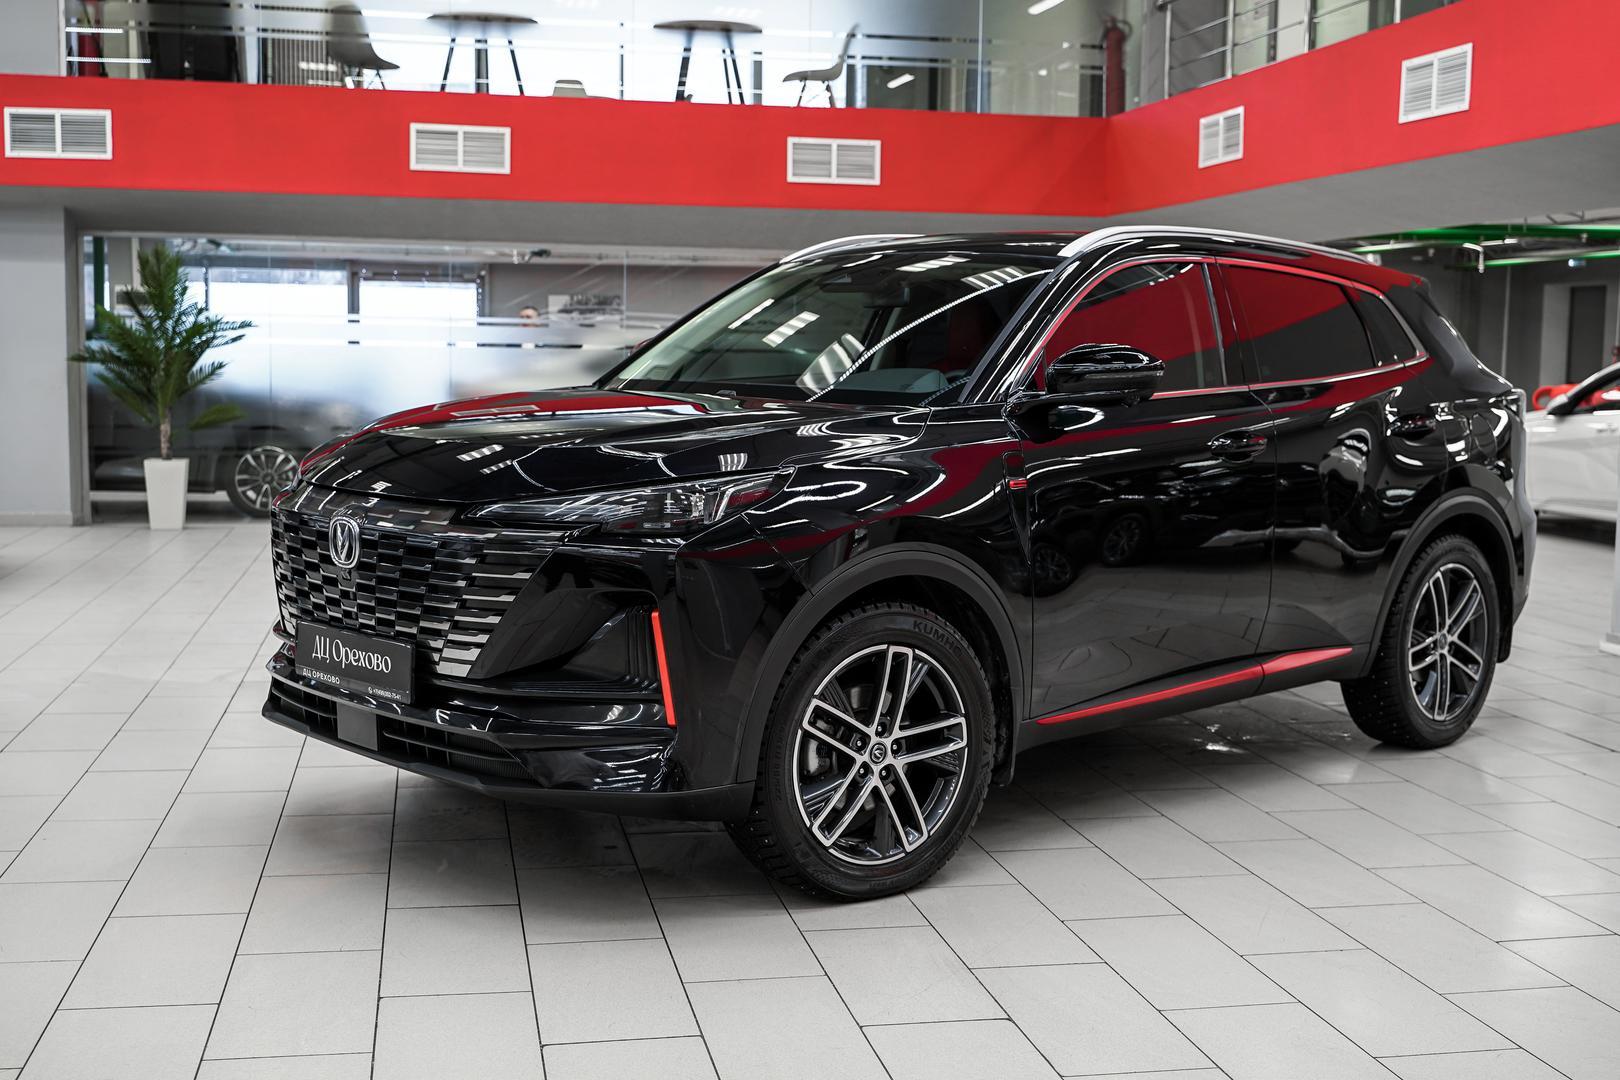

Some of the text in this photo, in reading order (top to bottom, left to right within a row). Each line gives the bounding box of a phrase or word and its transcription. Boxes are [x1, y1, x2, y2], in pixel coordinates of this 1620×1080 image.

[312, 635, 391, 673] ДЦ Орехово
[302, 668, 340, 685] ДЦ ОРЕХОВО
